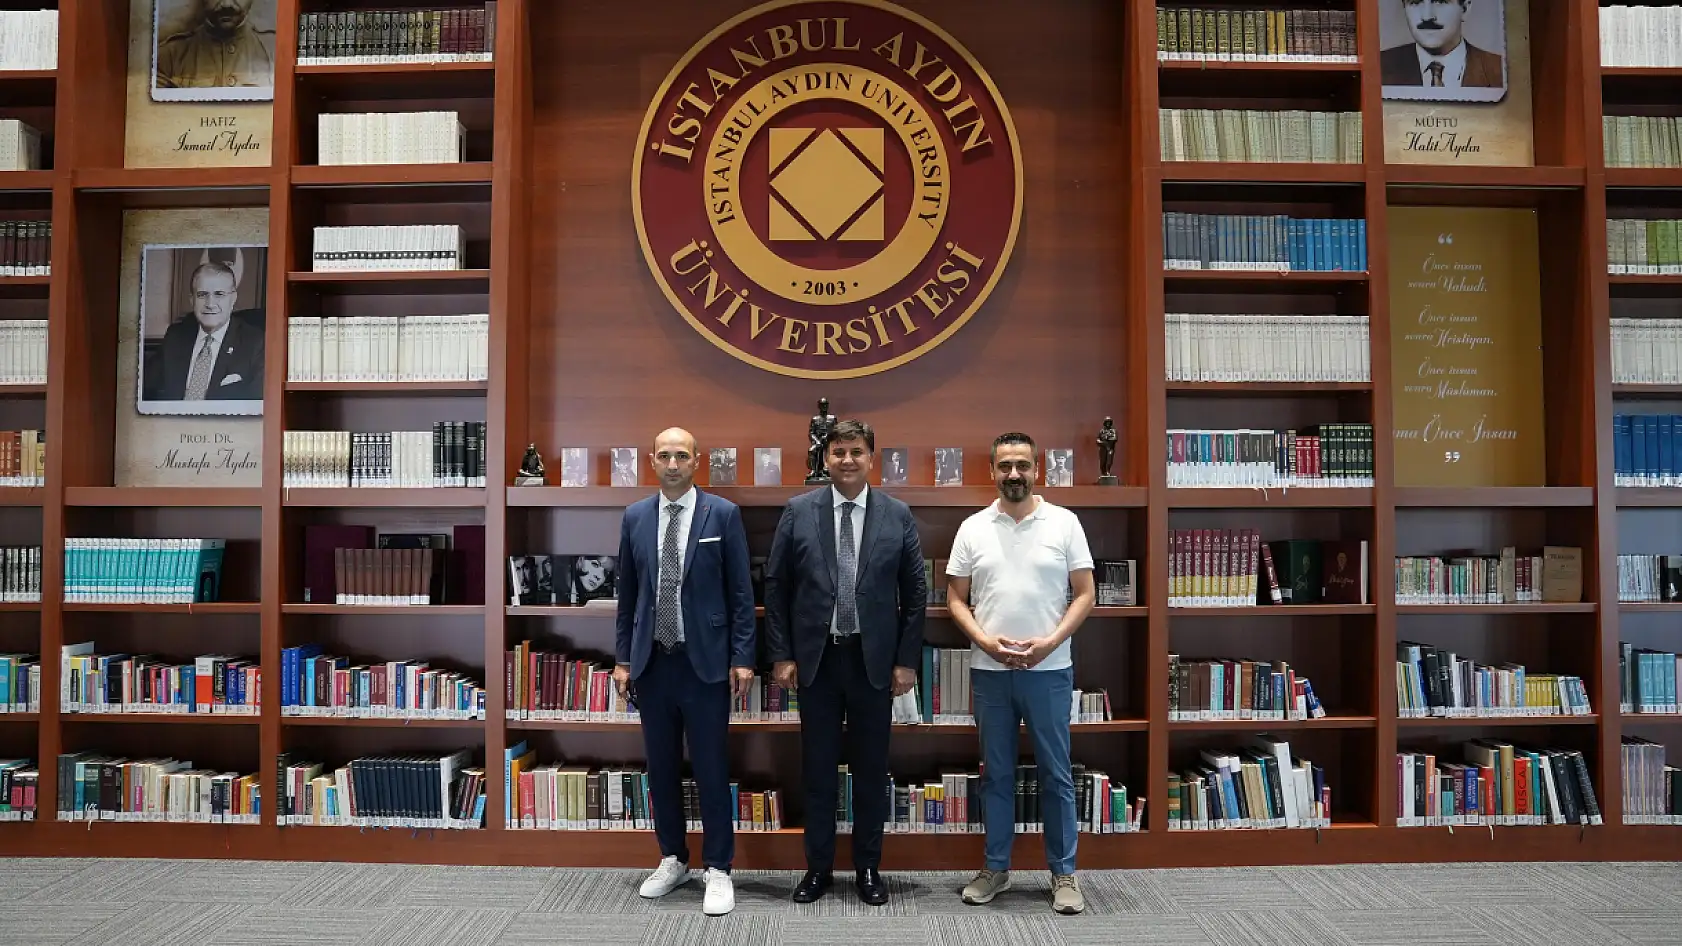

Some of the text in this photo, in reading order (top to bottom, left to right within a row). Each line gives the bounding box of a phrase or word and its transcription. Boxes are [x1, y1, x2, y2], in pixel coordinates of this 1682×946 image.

[651, 17, 993, 163] İSTANBUL AYDIN
[200, 116, 236, 128] HAFIZ
[1415, 116, 1458, 128] MÜFTÜ
[172, 128, 260, 156] İsmail Aydın
[711, 72, 943, 229] ISTANBUL AYDIN UNIVERSITY
[1403, 131, 1480, 158] Halit Aydın
[1422, 252, 1482, 274] Önce insan
[670, 238, 985, 356] ÜNİVERSİTESİ
[803, 280, 847, 296] 2003
[1418, 304, 1478, 325] Önce insan
[1418, 356, 1478, 378] Önce insan
[1422, 414, 1464, 443] Önce
[1466, 414, 1517, 443] İnsan
[155, 448, 257, 475] Mustafa Aydın
